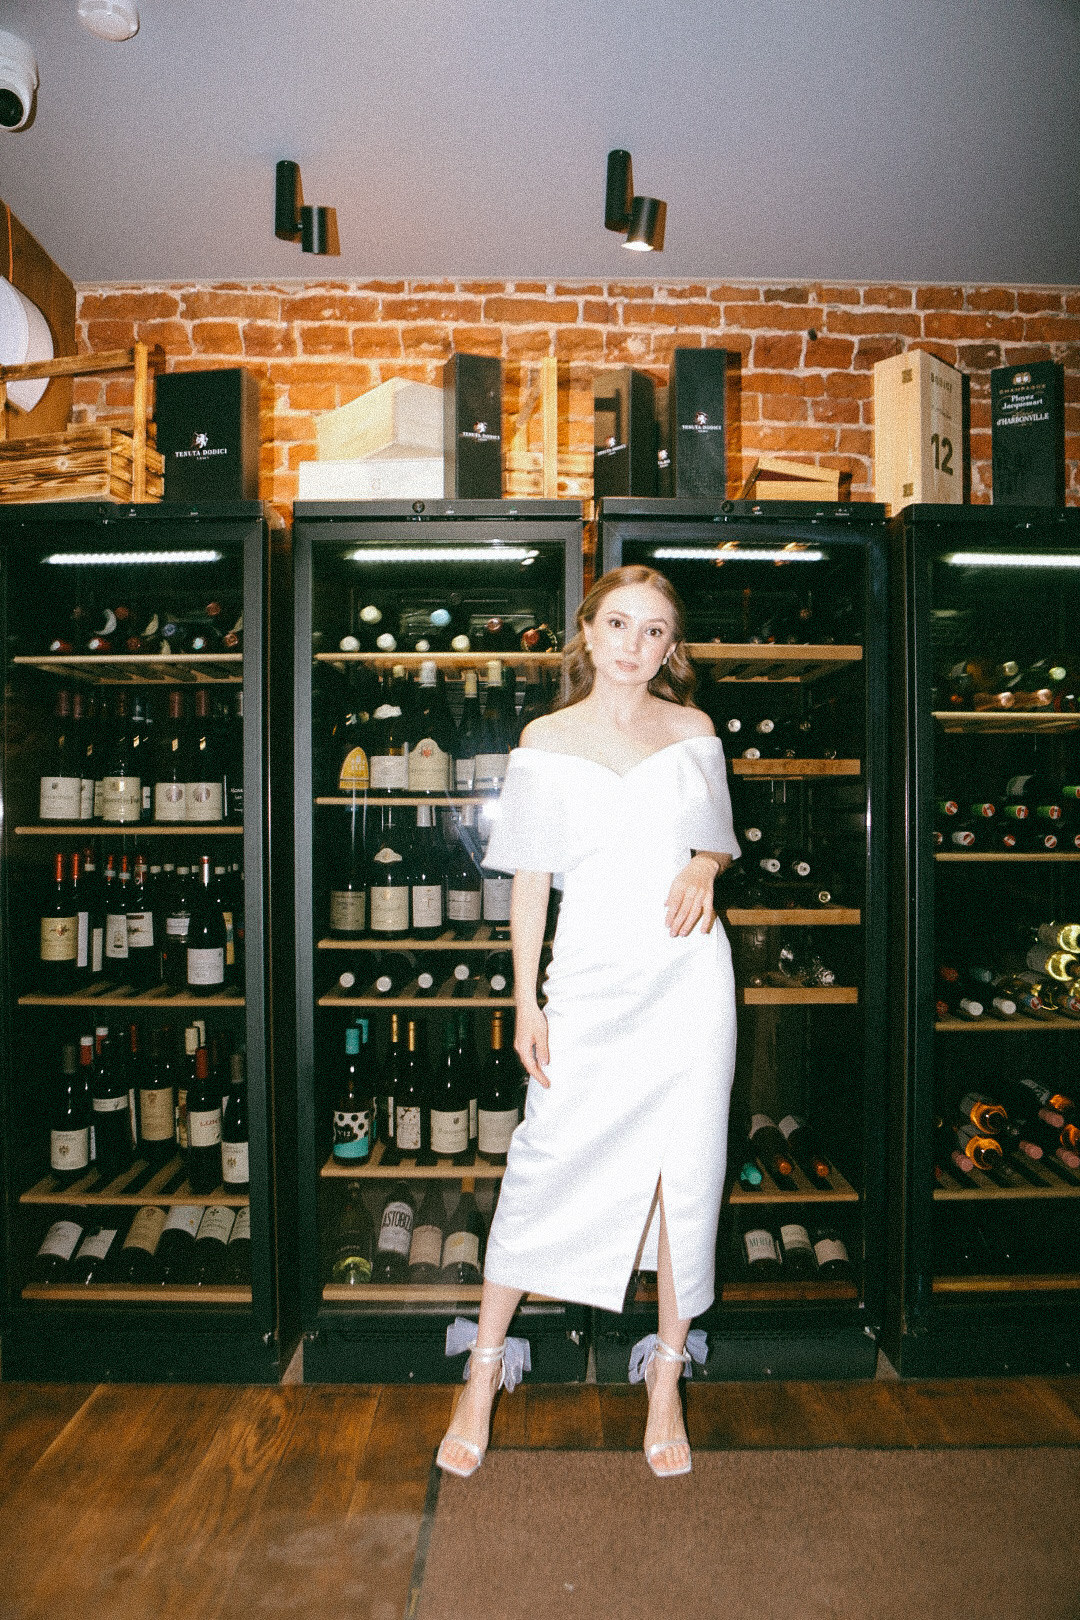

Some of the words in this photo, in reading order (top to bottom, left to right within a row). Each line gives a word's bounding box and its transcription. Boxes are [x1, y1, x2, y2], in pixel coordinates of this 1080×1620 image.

[999, 384, 1046, 394] CHAMPAGNE
[1002, 399, 1043, 410] Jacquemart
[931, 433, 954, 476] 12
